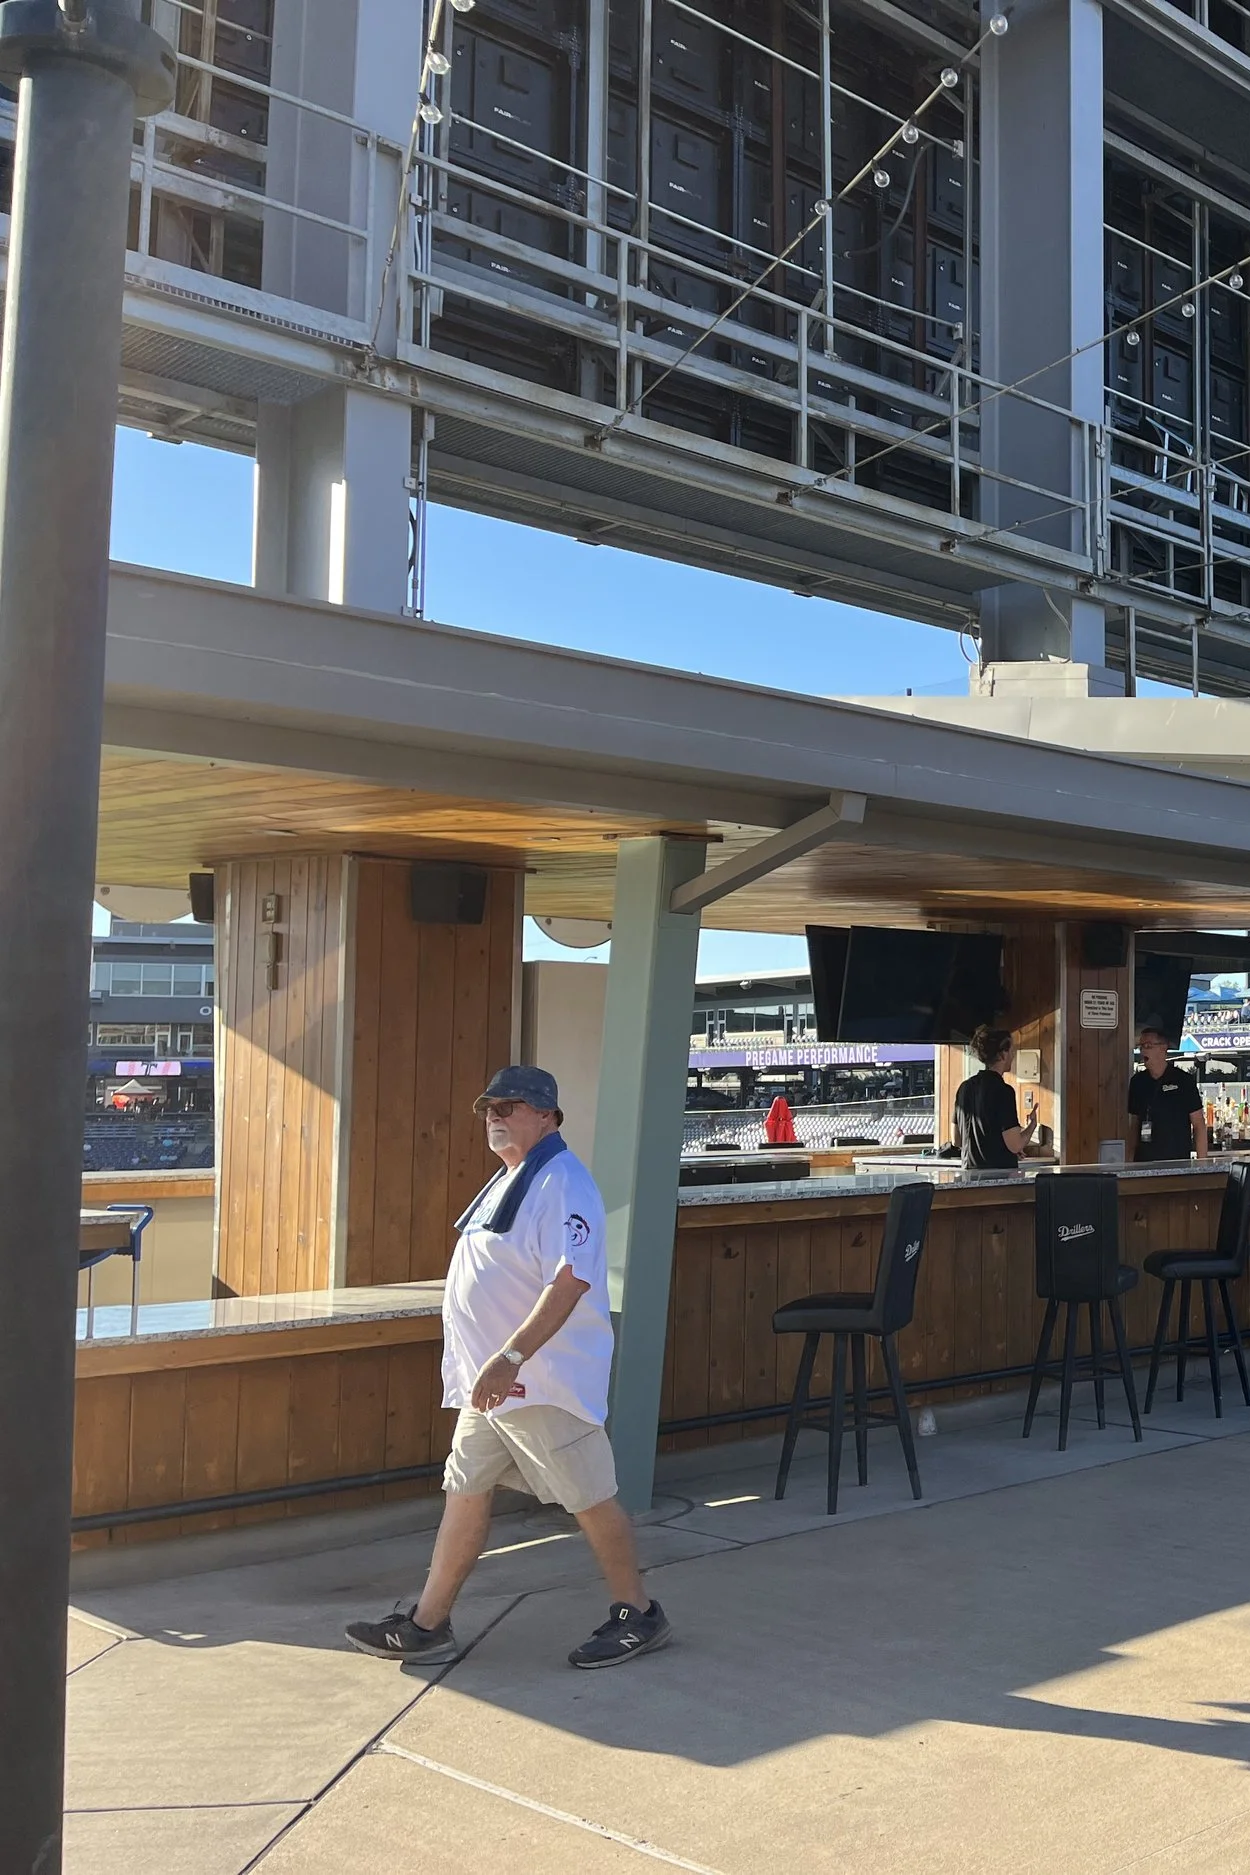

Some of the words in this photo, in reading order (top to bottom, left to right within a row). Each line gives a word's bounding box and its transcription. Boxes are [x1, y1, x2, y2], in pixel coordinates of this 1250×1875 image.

[1201, 1036, 1232, 1048] CRACK
[745, 1049, 794, 1067] PREGAME
[797, 1045, 879, 1066] PERFORMANCE
[1058, 1224, 1096, 1241] Drillers
